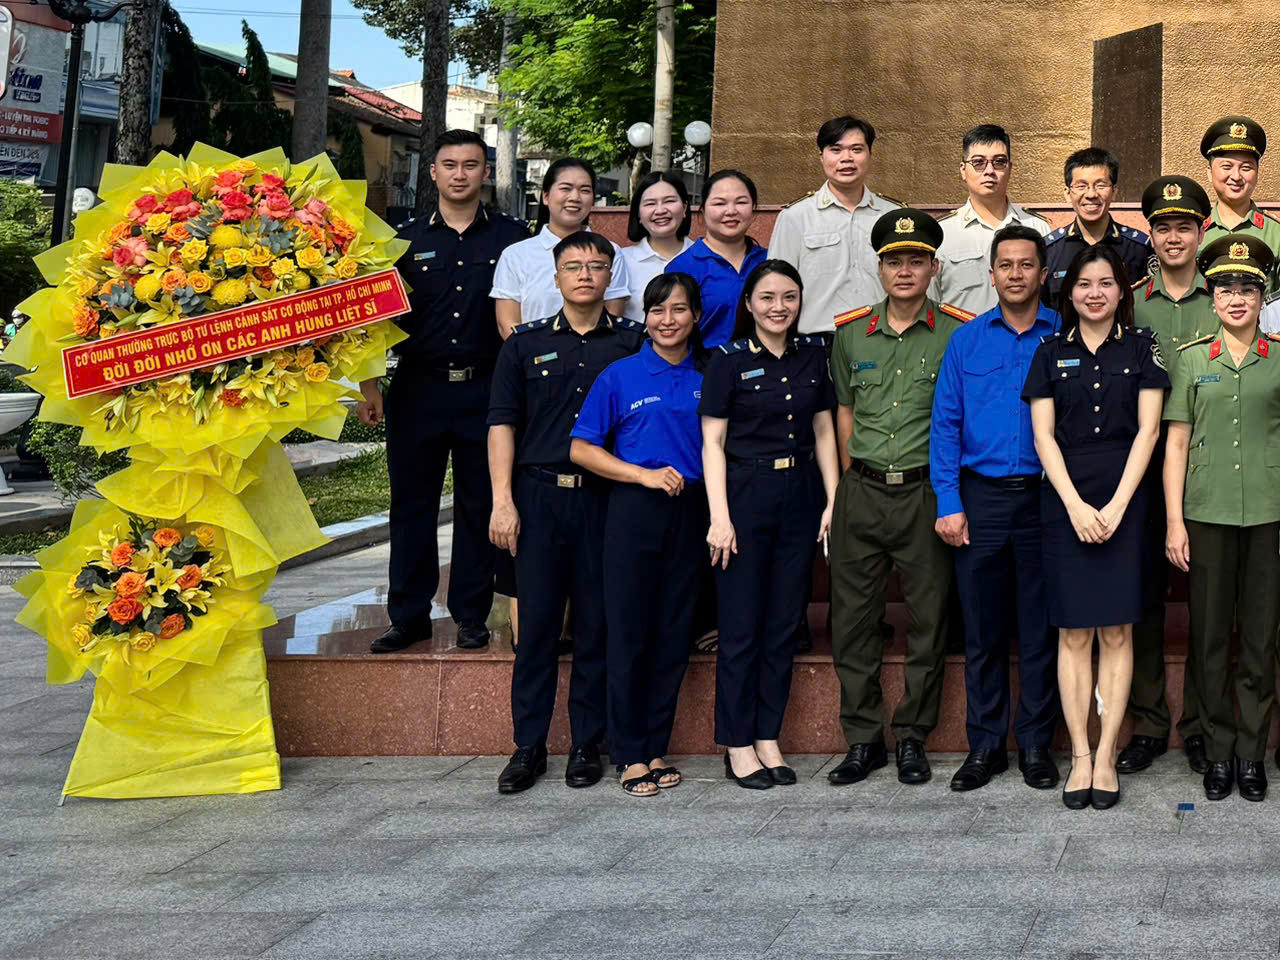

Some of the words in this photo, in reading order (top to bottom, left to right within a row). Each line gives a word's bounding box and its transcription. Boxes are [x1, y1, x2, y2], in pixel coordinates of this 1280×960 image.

[75, 353, 88, 367] CƠ
[90, 349, 114, 364] QUAN
[117, 338, 153, 357] THƯỜNG
[154, 331, 179, 349] TRỰC
[182, 327, 194, 344] BỘ
[195, 324, 208, 338] TƯ
[211, 318, 234, 336] LỆNH
[235, 313, 260, 328] CẢNH
[263, 307, 278, 323] SÁT
[281, 302, 294, 317] CƠ
[295, 298, 318, 315] ĐỘNG
[319, 295, 332, 310] TẠI
[332, 292, 345, 306] TP.
[346, 286, 356, 302] HỒ
[357, 284, 370, 298] CHÍ
[372, 280, 393, 293] MINH
[103, 361, 130, 381] ĐỜI
[133, 354, 161, 374] ĐỜI
[165, 344, 197, 366] NHỚ
[201, 337, 223, 357] ƠN
[227, 329, 257, 352] CÁC
[261, 326, 291, 343] ANH
[295, 313, 333, 335] HÙNG
[336, 304, 361, 324] LIỆT
[365, 297, 378, 316] SĨ
[630, 400, 643, 410] ACV
